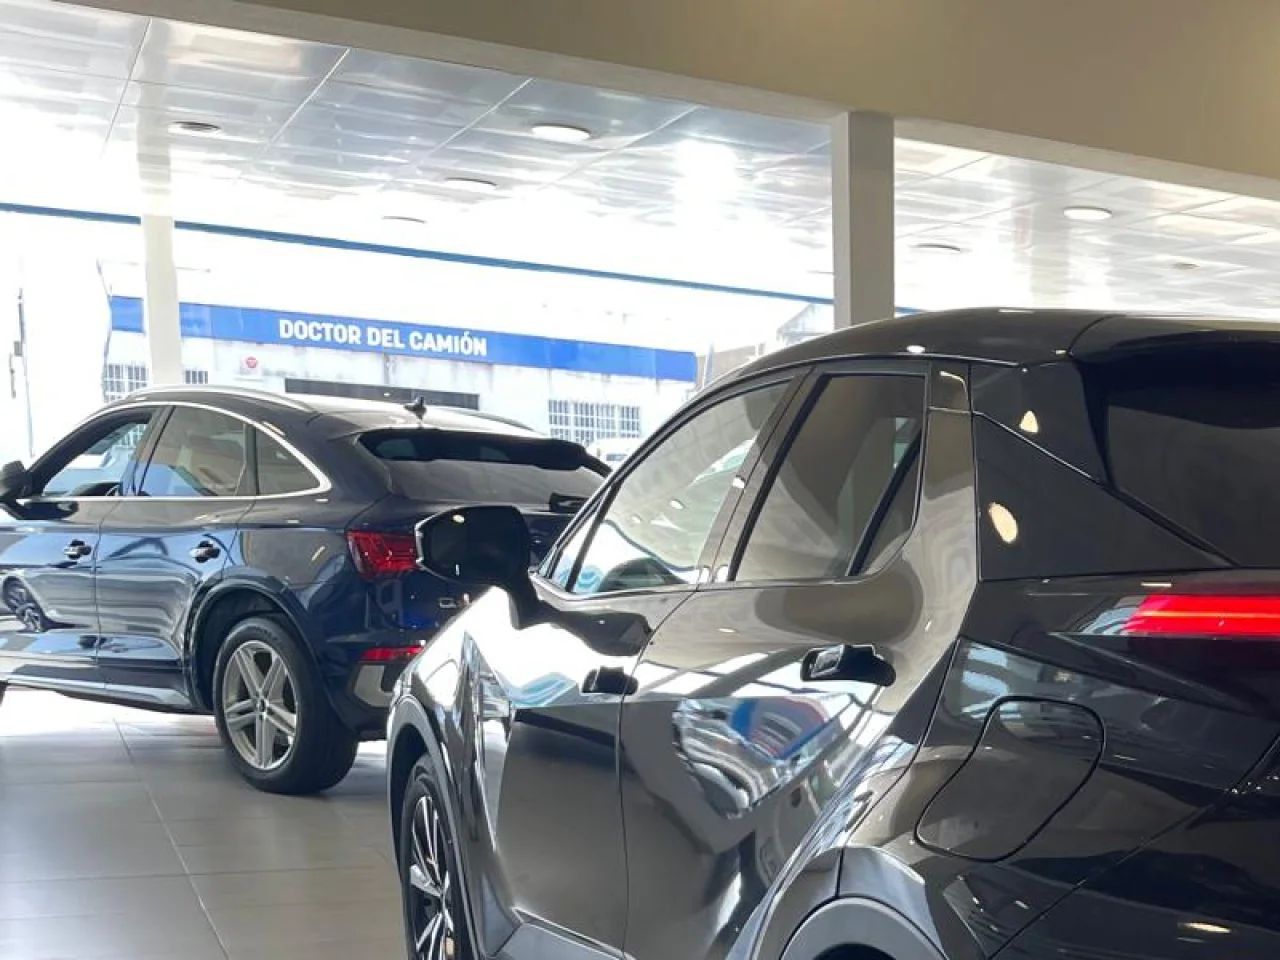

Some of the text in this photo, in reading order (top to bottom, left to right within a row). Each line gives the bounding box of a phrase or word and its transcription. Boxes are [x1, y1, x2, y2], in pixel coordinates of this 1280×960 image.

[279, 318, 487, 357] DOCTOR DEL CAMIÓN
